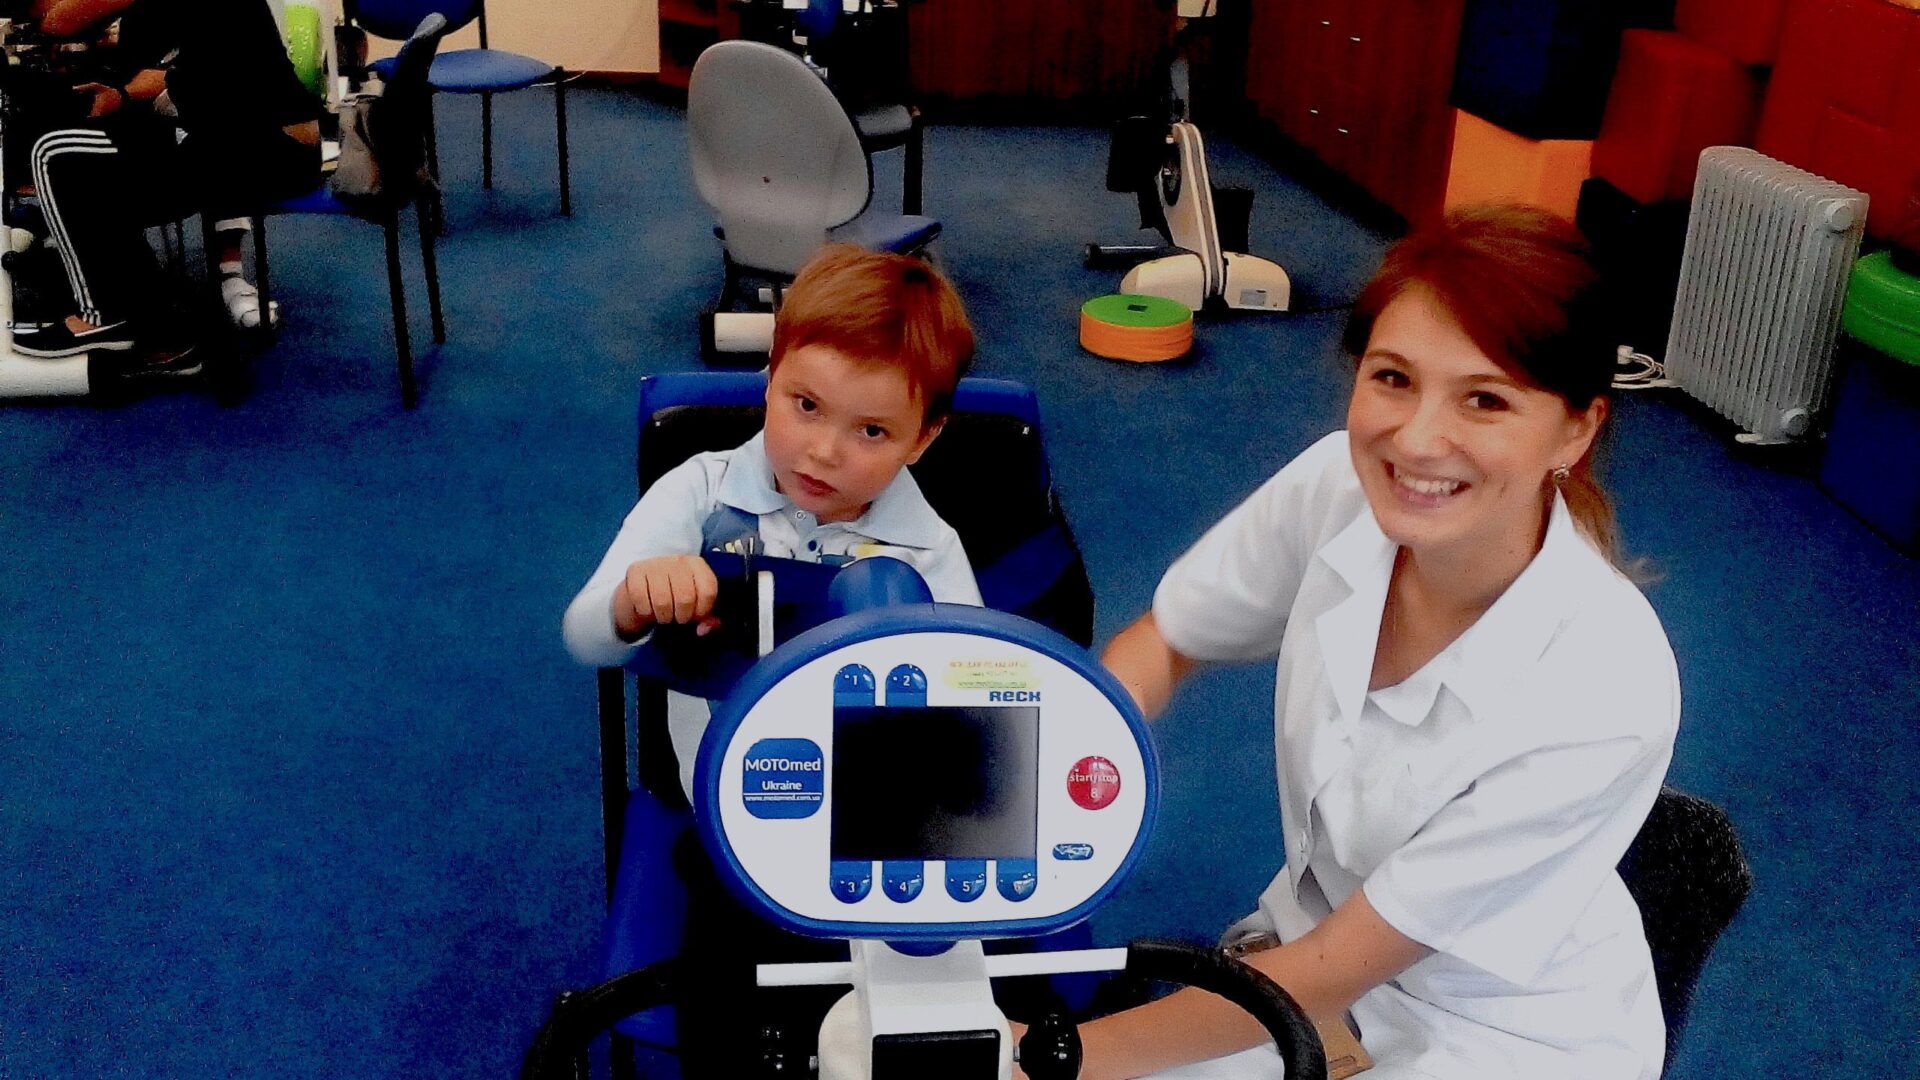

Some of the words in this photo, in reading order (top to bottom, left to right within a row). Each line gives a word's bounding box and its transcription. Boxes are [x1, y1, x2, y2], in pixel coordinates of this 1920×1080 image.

[852, 675, 858, 686] 1
[903, 675, 911, 687] 2
[745, 758, 822, 772] MOTOmed
[761, 780, 803, 791] Ukraine
[847, 881, 856, 893] 3
[899, 881, 907, 892] 4
[962, 880, 971, 892] 5
